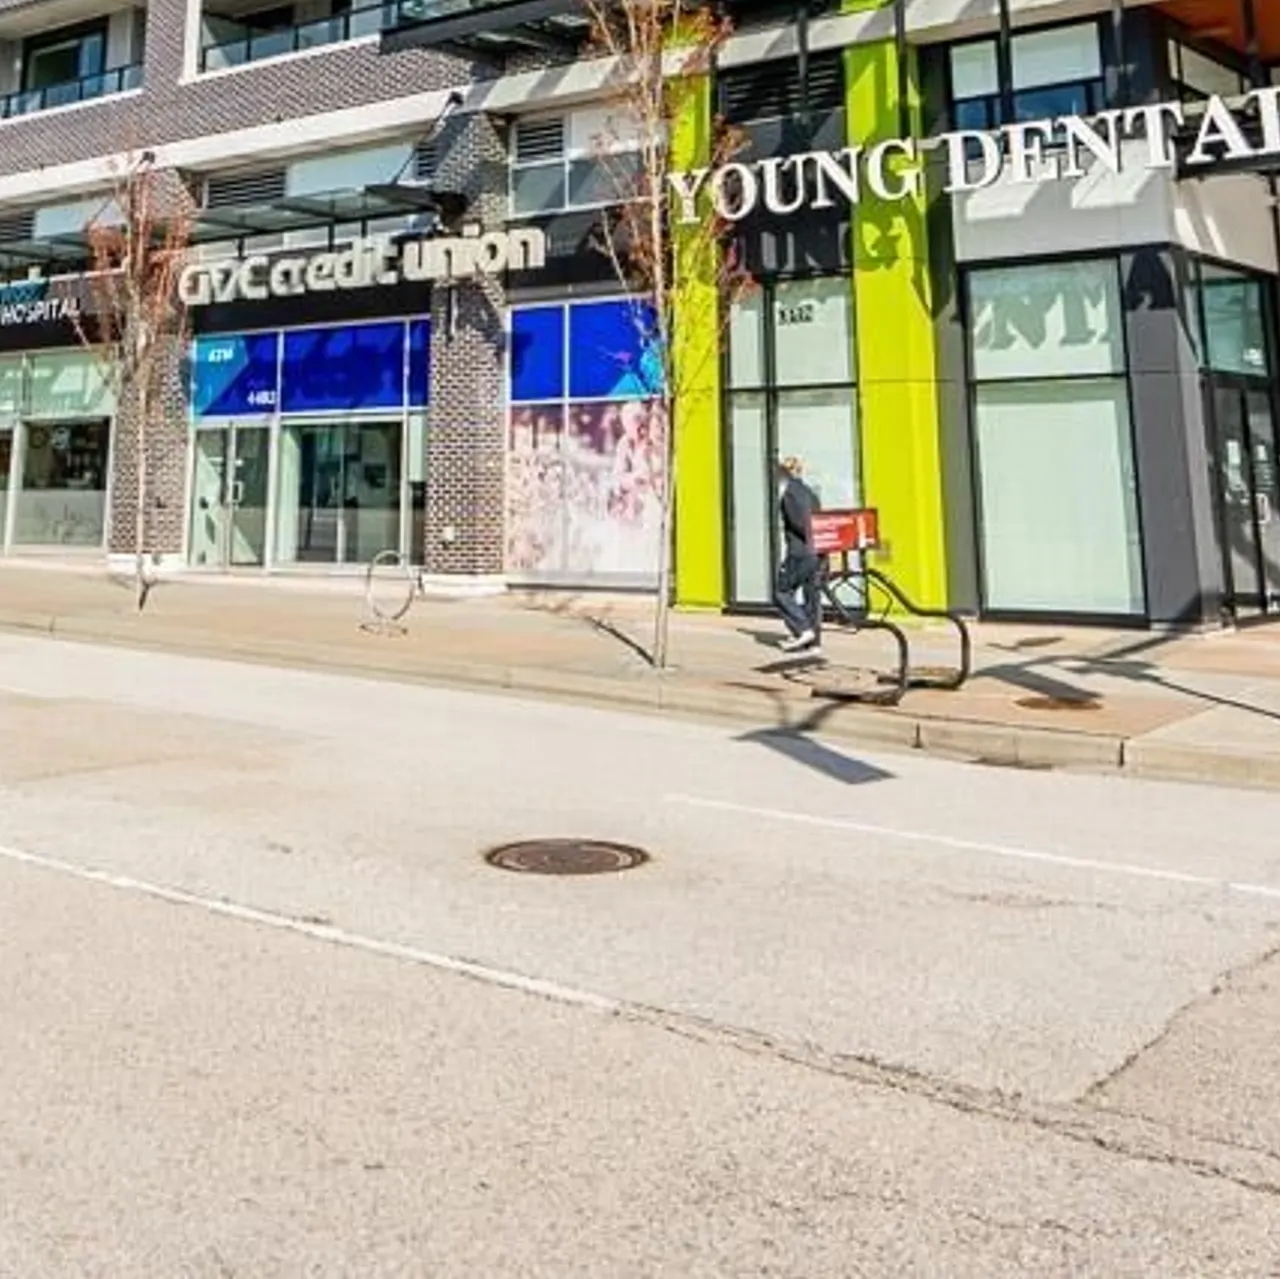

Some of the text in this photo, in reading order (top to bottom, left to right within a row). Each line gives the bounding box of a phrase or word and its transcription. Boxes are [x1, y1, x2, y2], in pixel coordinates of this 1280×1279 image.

[667, 137, 924, 225] YOUNG
[270, 233, 398, 297] credit
[403, 224, 546, 282] union
[1, 297, 81, 328] HOSPITAL
